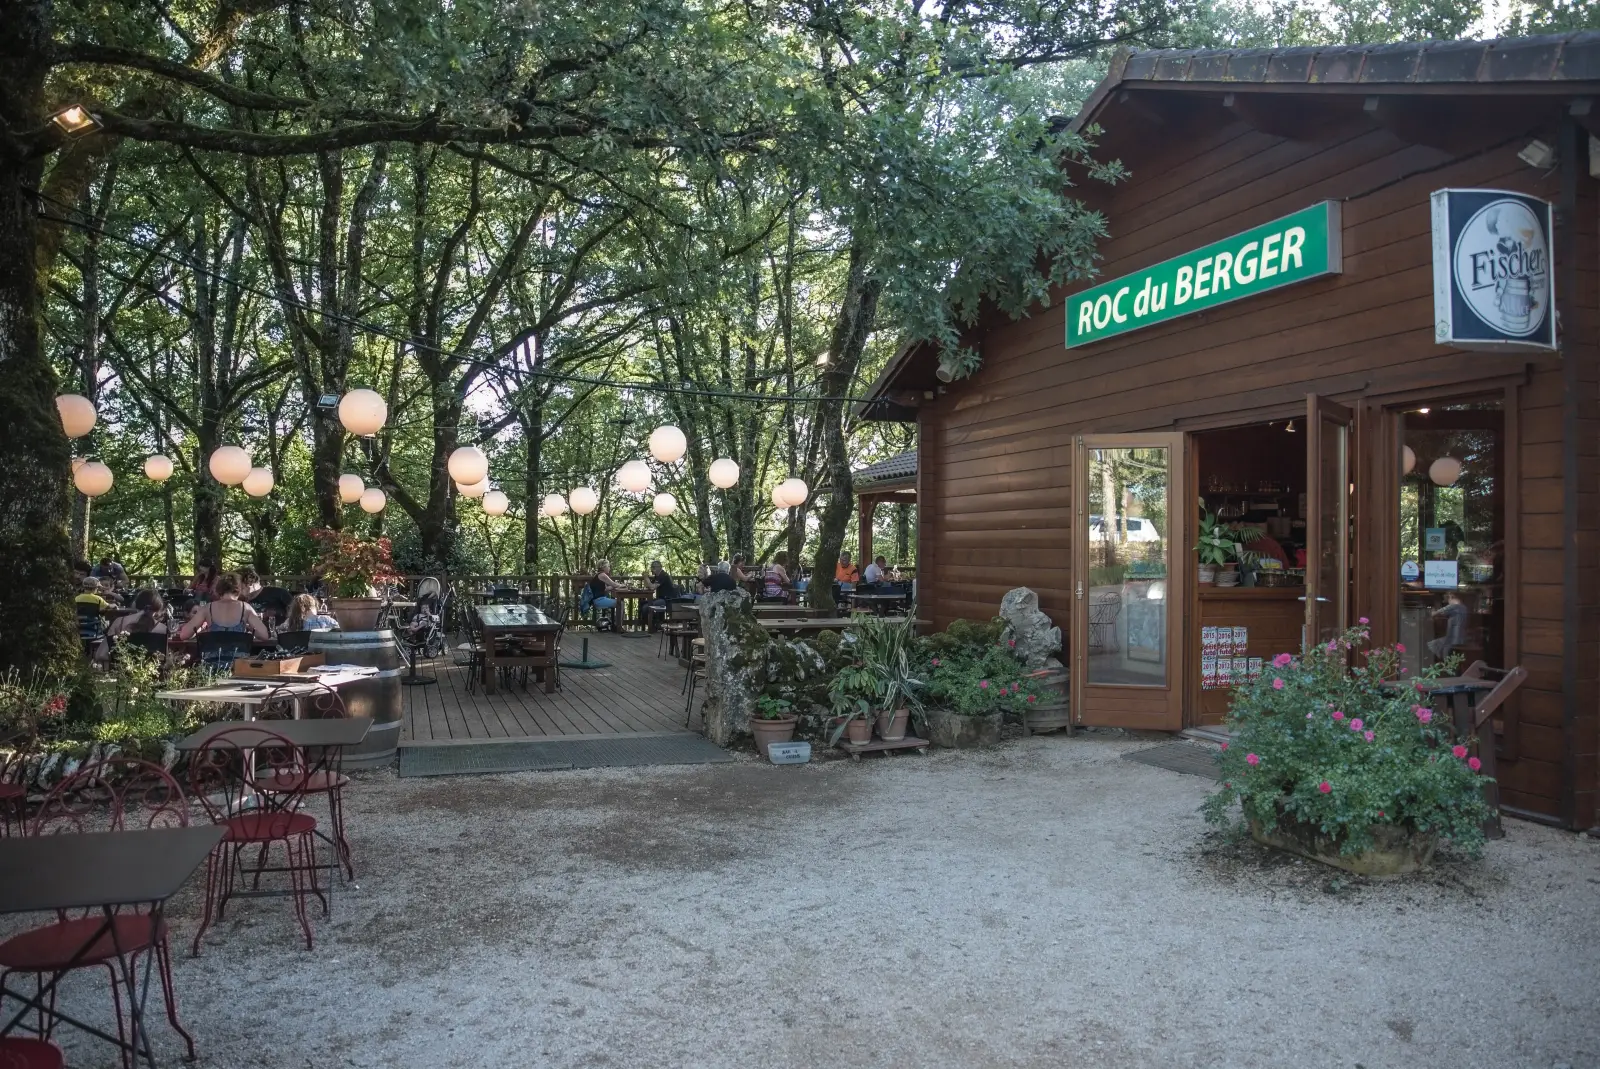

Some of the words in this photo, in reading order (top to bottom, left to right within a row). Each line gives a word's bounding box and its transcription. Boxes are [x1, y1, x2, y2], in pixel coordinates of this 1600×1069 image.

[1077, 286, 1130, 336] ROC
[1133, 276, 1168, 318] du
[1173, 226, 1306, 306] BERGER
[1470, 242, 1544, 286] Fischer
